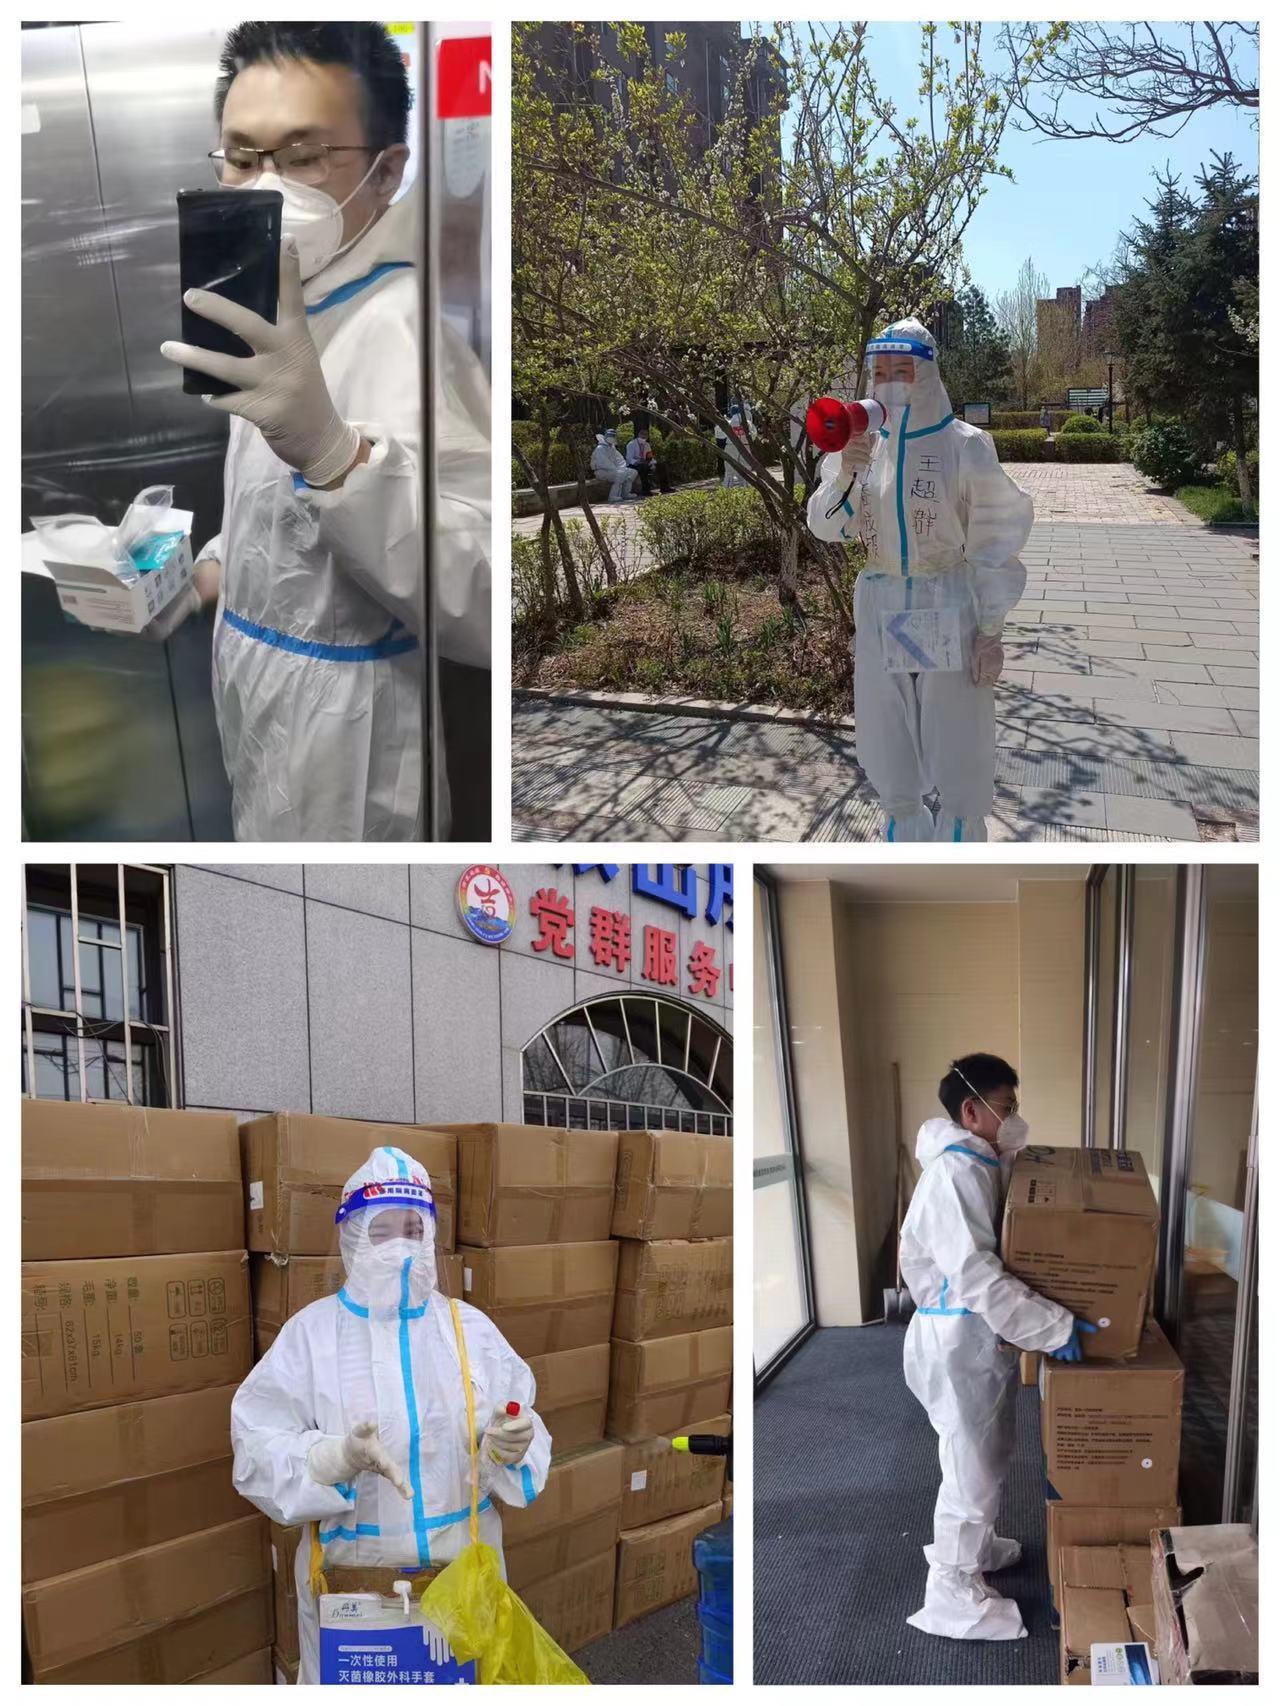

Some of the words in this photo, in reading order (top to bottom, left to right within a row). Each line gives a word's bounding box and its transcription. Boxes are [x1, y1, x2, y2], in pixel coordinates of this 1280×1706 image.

[910, 455, 941, 537] 王超群
[530, 887, 734, 997] 党群服务
[338, 1655, 398, 1667] 一次性使用
[338, 1670, 435, 1683] 灭菌橡胶外科手套
